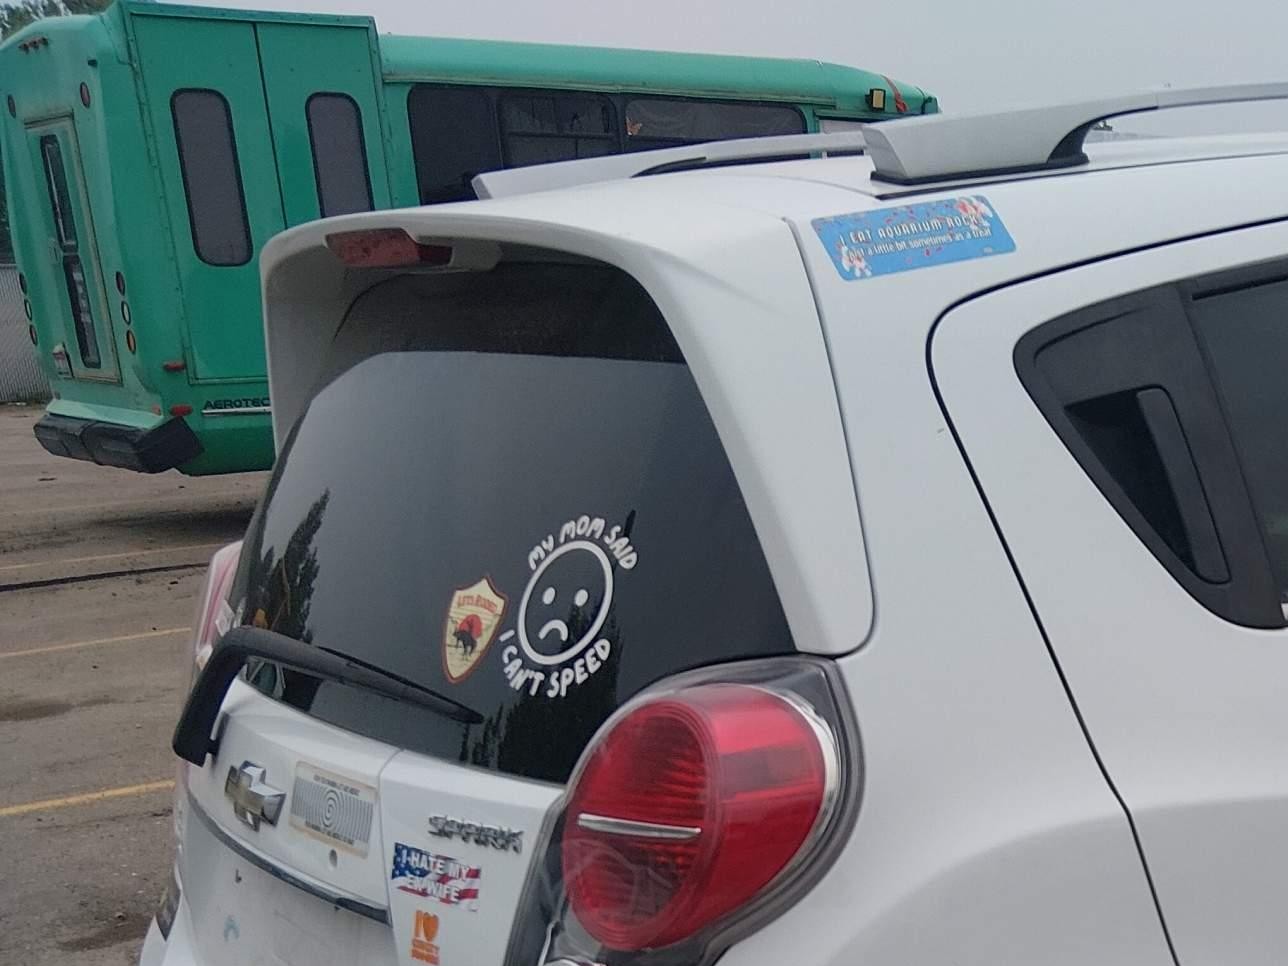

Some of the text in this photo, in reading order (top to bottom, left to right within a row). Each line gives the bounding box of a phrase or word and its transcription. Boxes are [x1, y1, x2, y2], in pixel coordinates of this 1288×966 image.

[850, 231, 873, 244] EAT
[877, 219, 944, 239] AQUARIUM
[909, 234, 953, 250] sometimes
[559, 514, 606, 544] MOM
[603, 525, 638, 570] SAID
[498, 629, 612, 698] I CAN'T SPEED
[410, 852, 445, 876] HATE
[448, 861, 470, 881] MY
